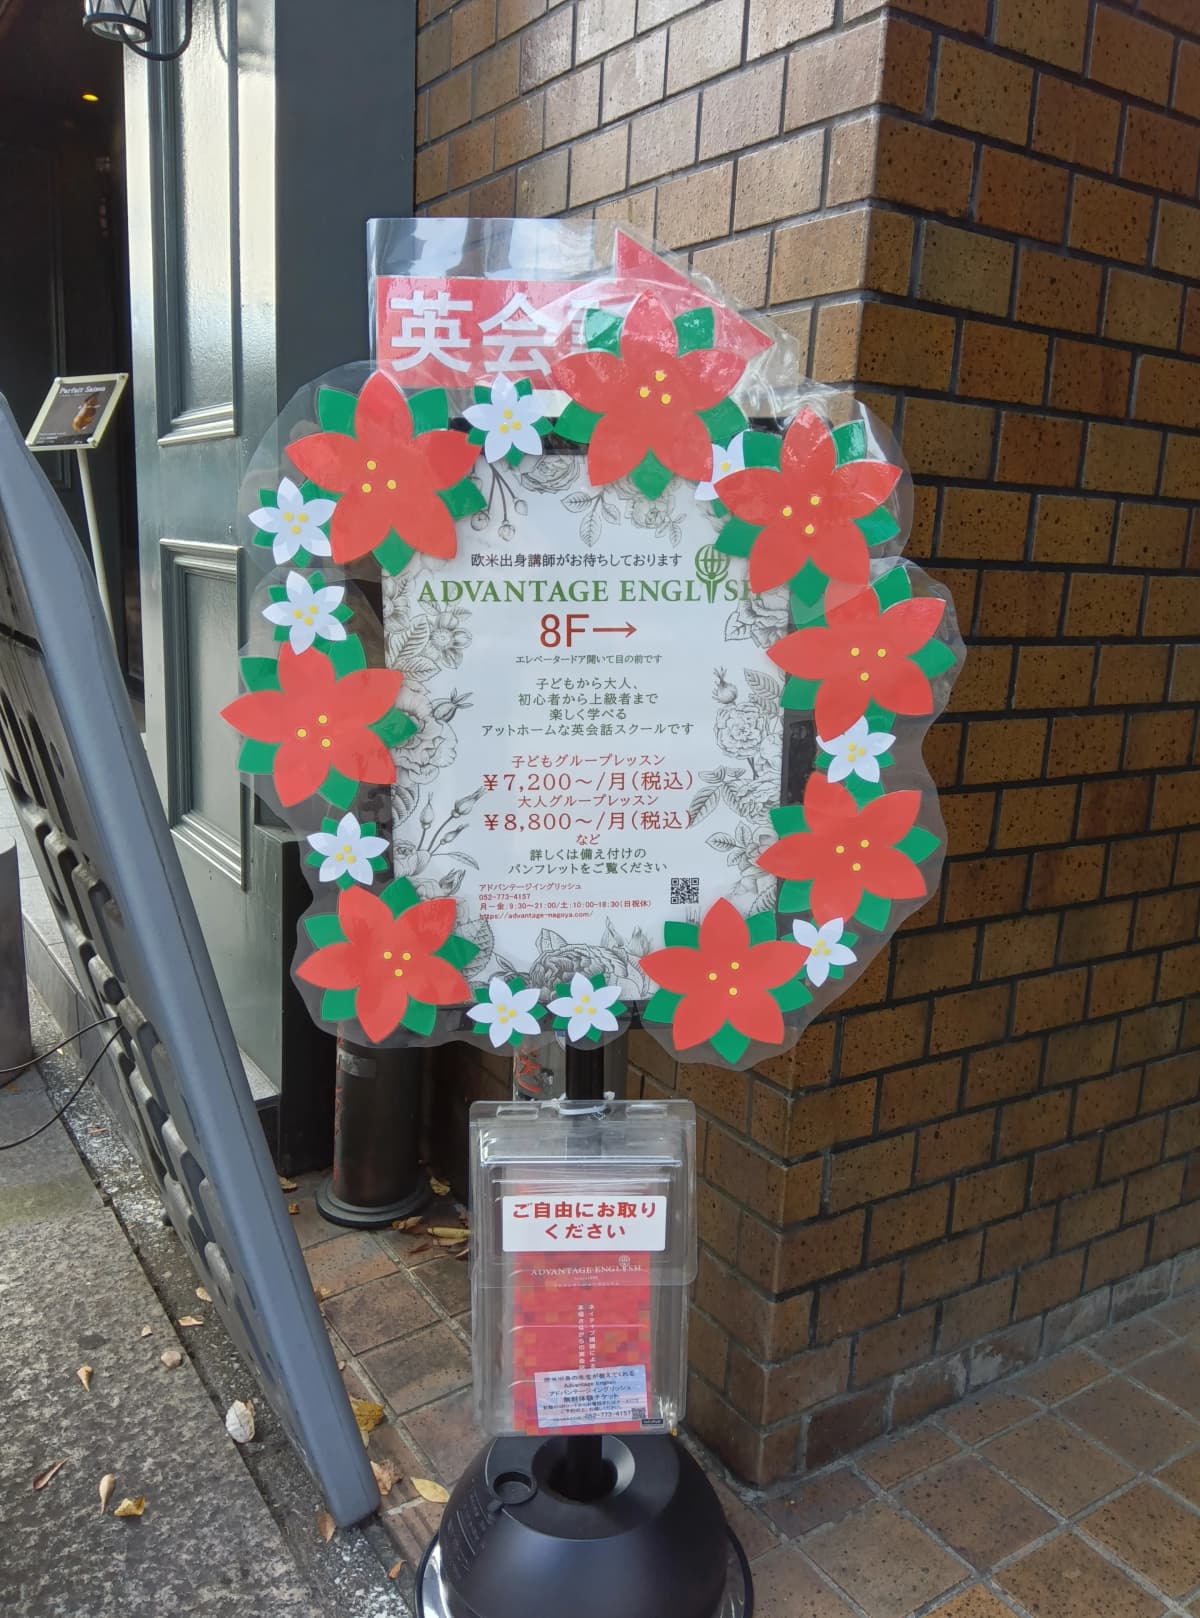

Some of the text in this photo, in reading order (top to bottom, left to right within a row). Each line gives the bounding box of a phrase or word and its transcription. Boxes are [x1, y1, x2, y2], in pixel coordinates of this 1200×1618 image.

[470, 553, 683, 568] 欧米出身講師がお待ちしております
[417, 579, 609, 603] ADVANTAGE
[540, 614, 590, 648] 8F
[515, 654, 663, 665] エレベータードア開いて目の前です
[535, 677, 639, 690] 子どもから大人、
[517, 693, 659, 706] 初心者から上級者まで
[549, 708, 628, 721] 楽しく学べる
[481, 722, 695, 737] アットホームな英会話スクールです
[511, 753, 666, 769] 子どもグループレッスン
[517, 794, 659, 809] 大人グループレッスン
[576, 834, 601, 846] など
[529, 847, 647, 862] 詳しくは備え付けの
[507, 862, 668, 875] パンフレットをご覧ください
[511, 1201, 657, 1219] ご自由にお取り
[544, 1223, 626, 1240] ください
[531, 1266, 592, 1276] ADVANTAGE
